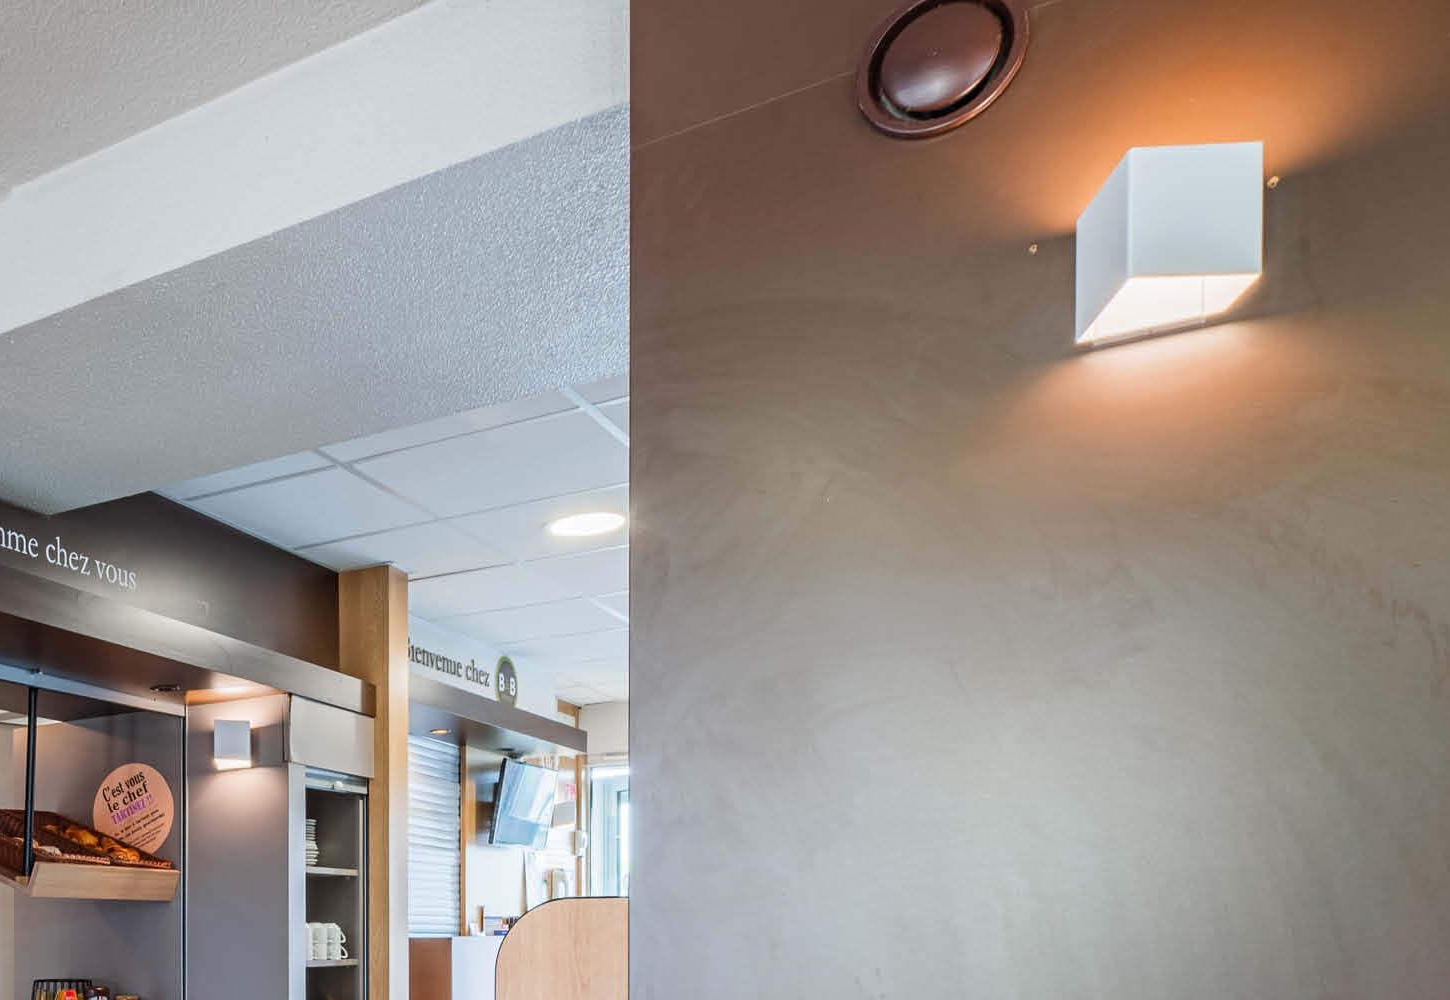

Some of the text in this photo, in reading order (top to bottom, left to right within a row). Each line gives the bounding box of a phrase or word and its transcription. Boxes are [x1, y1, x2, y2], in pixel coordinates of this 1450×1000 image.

[45, 537, 91, 577] chez
[94, 558, 138, 591] vous
[465, 658, 491, 688] chez
[122, 781, 148, 806] chef
[124, 771, 145, 790] vous
